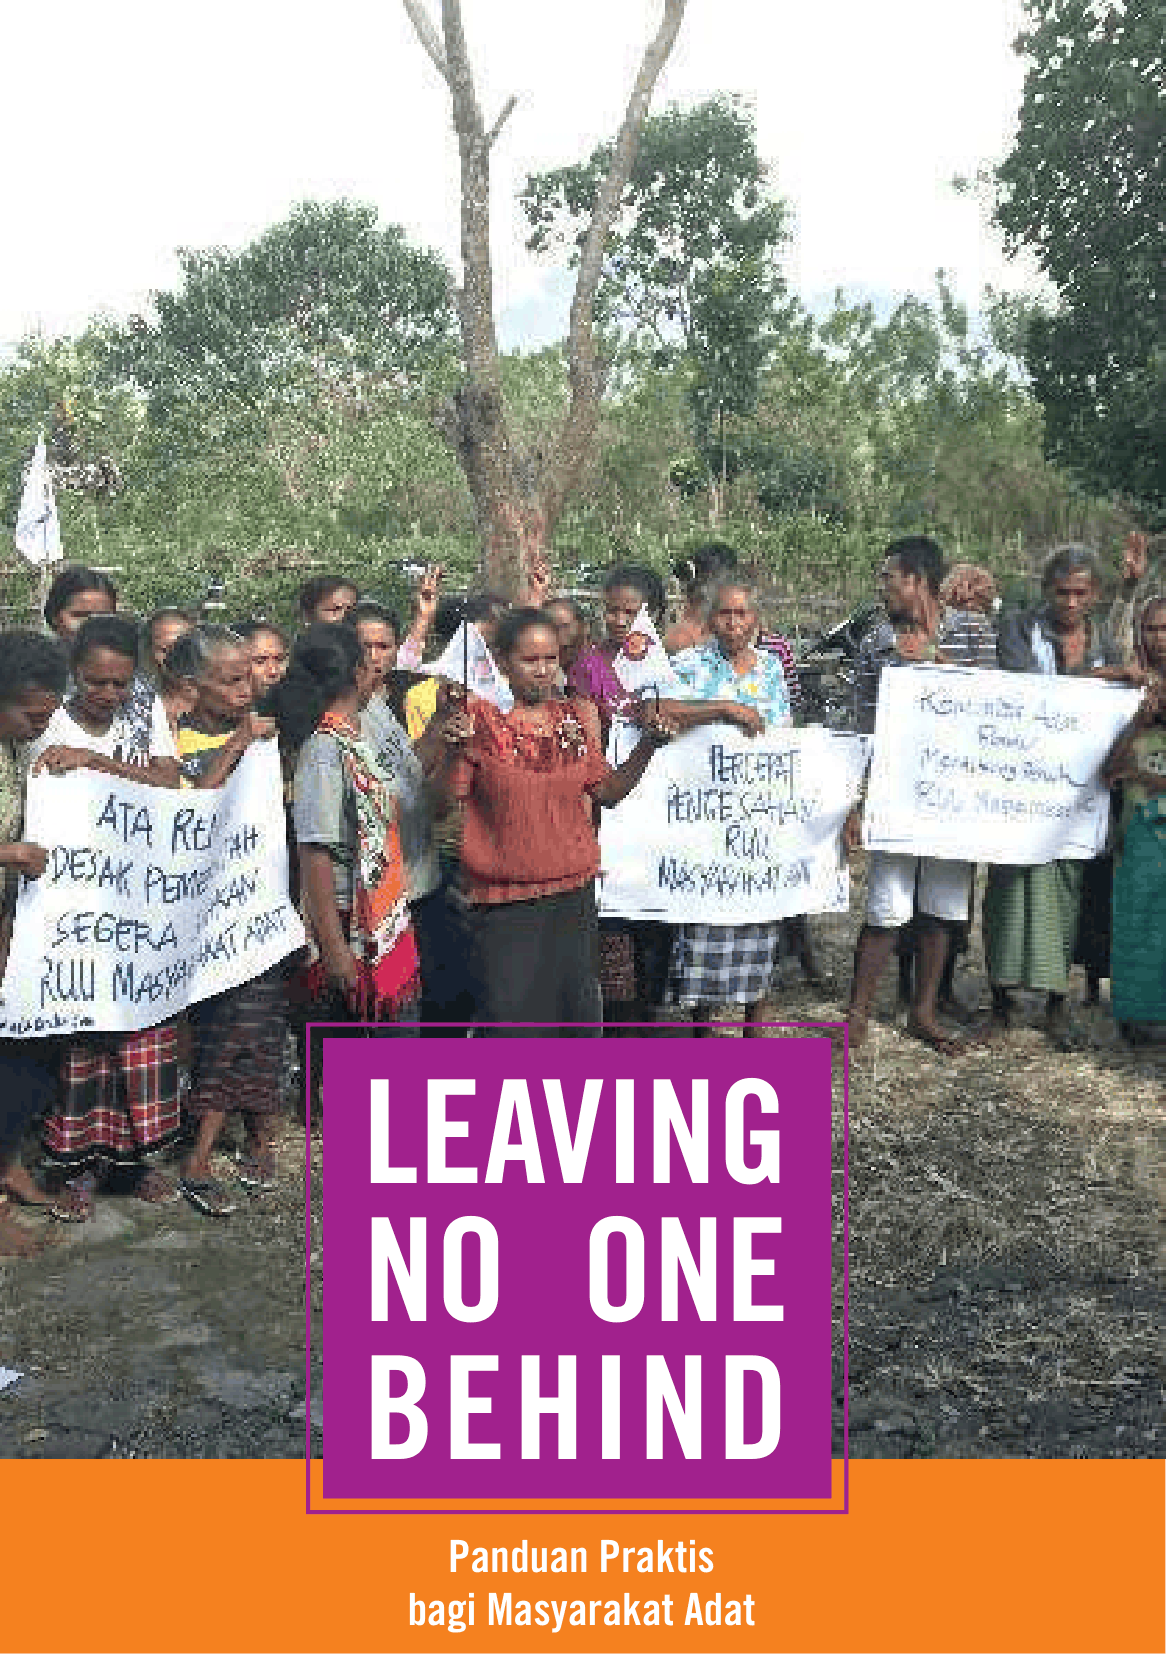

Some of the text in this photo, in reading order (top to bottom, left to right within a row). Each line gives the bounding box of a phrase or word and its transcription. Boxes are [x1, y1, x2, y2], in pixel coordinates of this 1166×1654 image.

[95, 792, 152, 847] ATA
[51, 844, 134, 897] DESAK
[51, 912, 178, 953] SEGERA
[40, 955, 95, 1009] RUU
